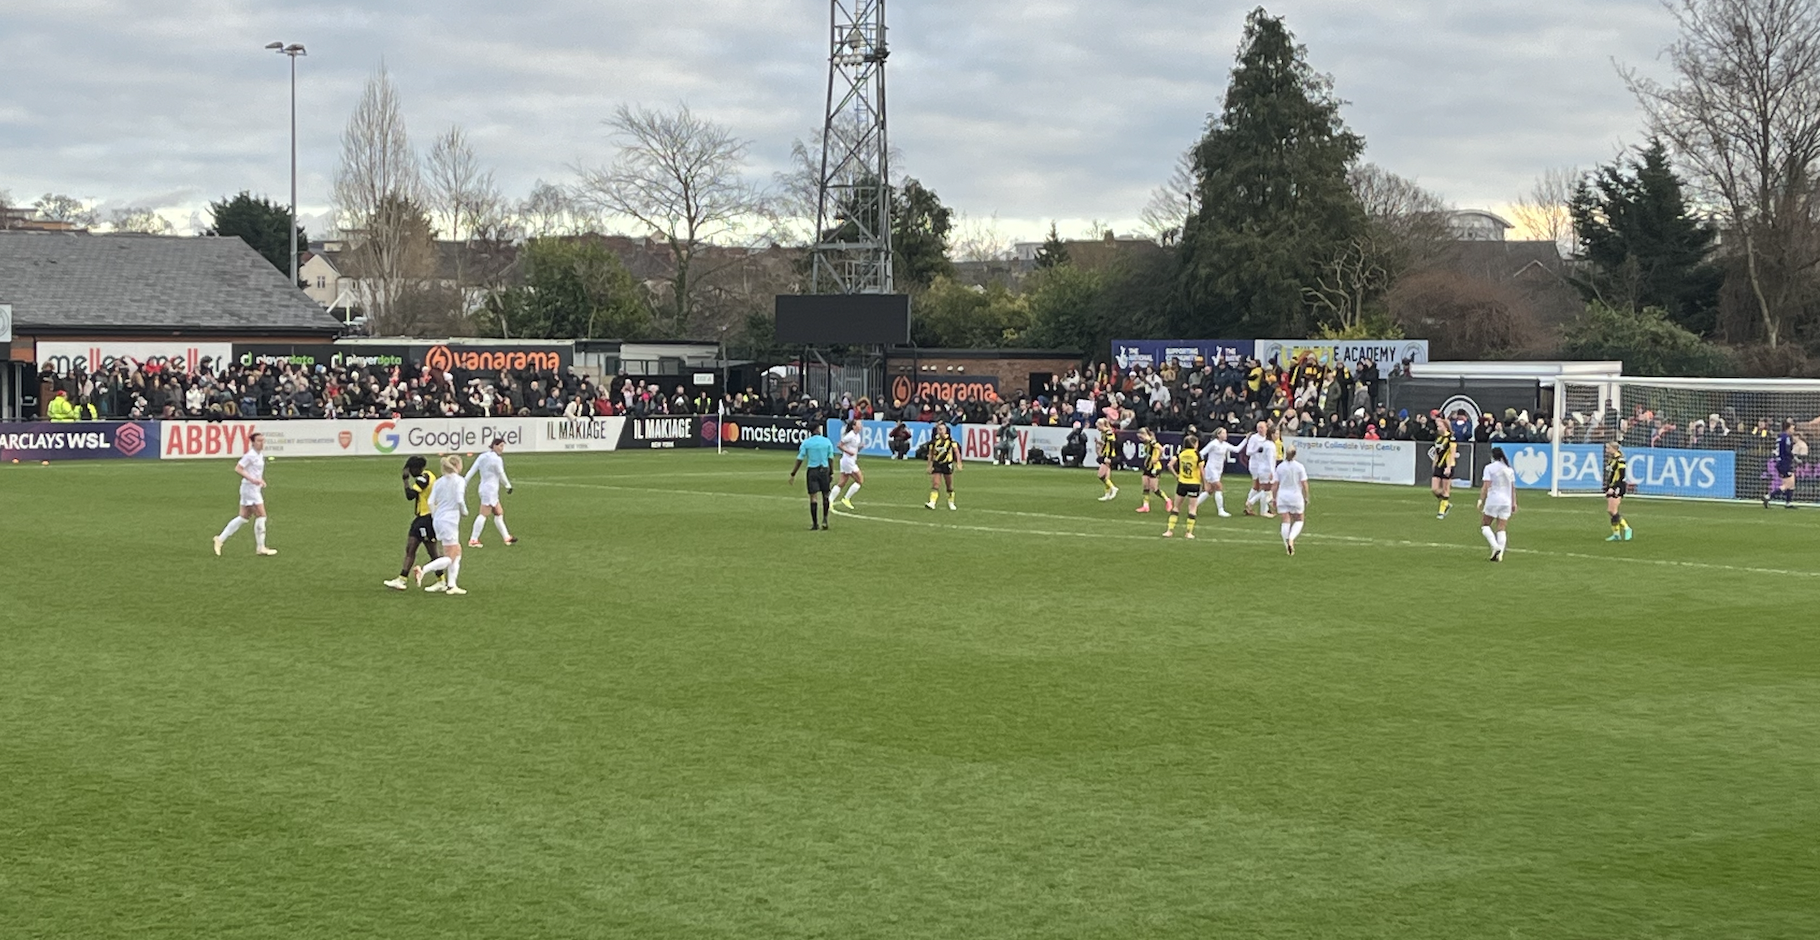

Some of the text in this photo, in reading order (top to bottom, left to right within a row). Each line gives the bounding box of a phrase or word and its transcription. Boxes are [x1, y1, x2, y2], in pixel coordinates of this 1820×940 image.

[50, 348, 118, 373] melle
[147, 348, 222, 373] mellr
[454, 351, 560, 370] vanarama
[1344, 347, 1396, 362] ACADEMY
[408, 426, 522, 451] Google Pixel
[559, 420, 607, 440] MAKIAGE
[645, 418, 692, 439] MAKIAGE
[741, 424, 823, 443] masterca
[0, 432, 110, 449] ARCLAYS WSL
[166, 425, 255, 454] ABBYY
[966, 428, 1028, 461] ABY
[1376, 442, 1401, 451] Centre
[1558, 451, 1715, 489] BACLAYS
